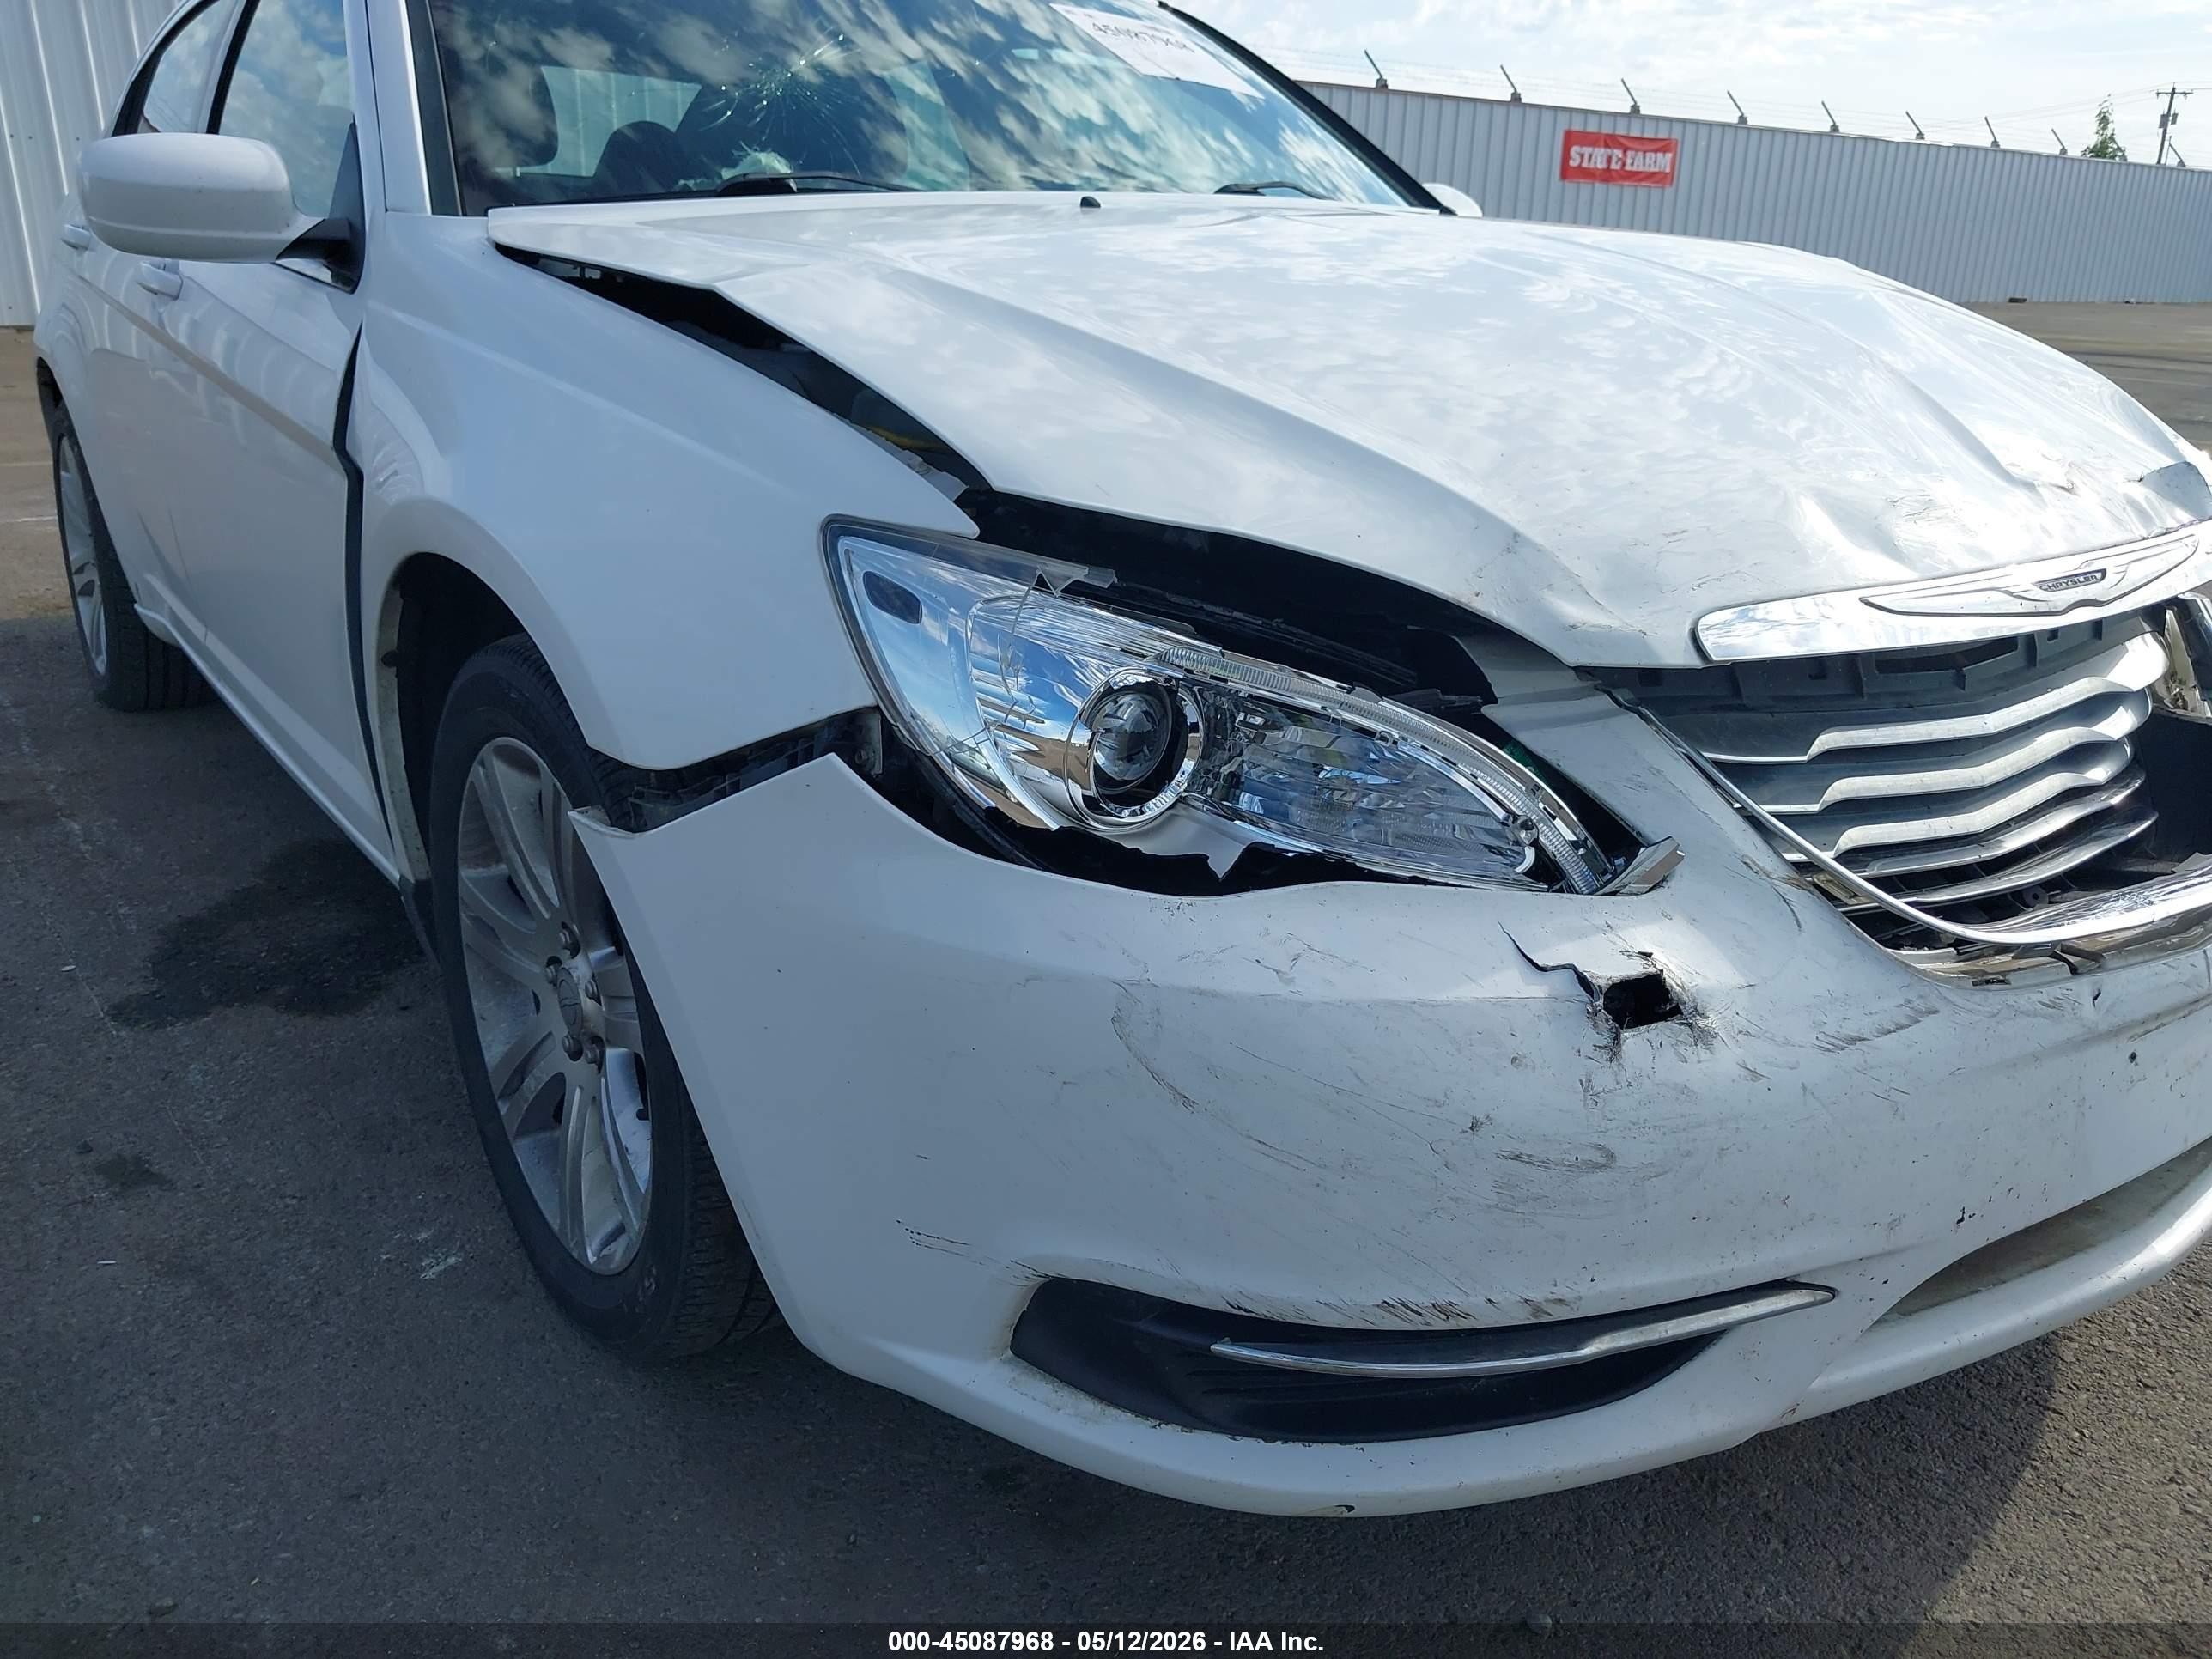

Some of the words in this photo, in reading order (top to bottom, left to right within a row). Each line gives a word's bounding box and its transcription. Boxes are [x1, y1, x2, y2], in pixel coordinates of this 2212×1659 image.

[1569, 145, 1623, 170] STATE
[1625, 150, 1673, 173] FARM
[2039, 574, 2099, 592] CHRYSLER
